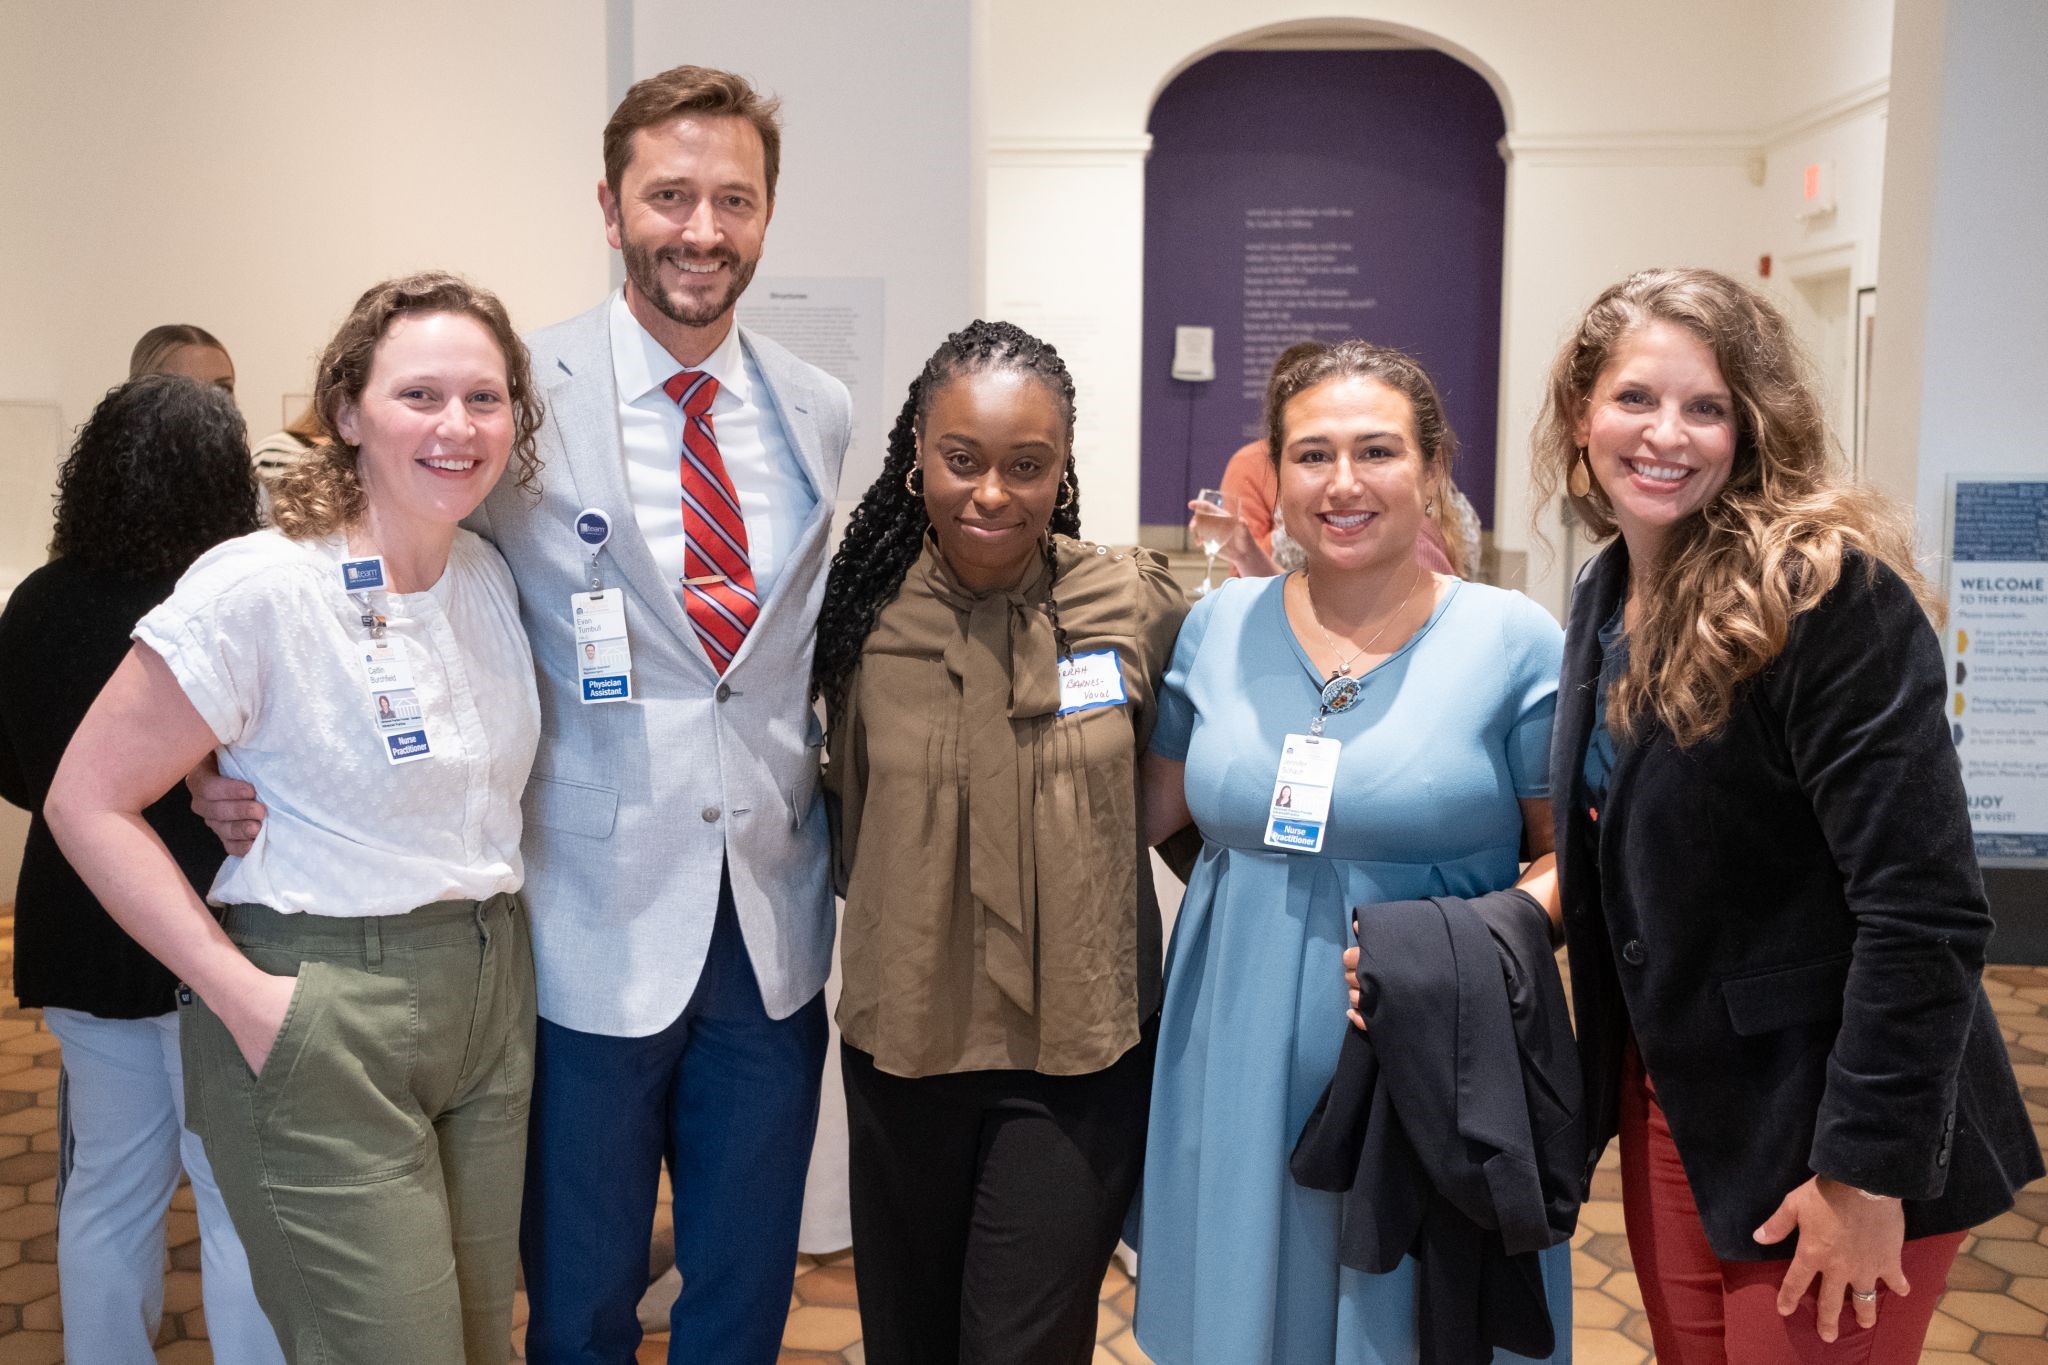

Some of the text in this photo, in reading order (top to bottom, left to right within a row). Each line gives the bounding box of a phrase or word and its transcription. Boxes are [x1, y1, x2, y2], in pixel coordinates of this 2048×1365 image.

[1960, 577, 2044, 591] WELCOME
[1960, 594, 1976, 605] TO
[1978, 594, 1999, 605] THE
[589, 679, 622, 690] Physician
[590, 687, 623, 697] Assistant
[398, 735, 417, 746] Nurse
[392, 743, 427, 757] Practitioner
[1967, 796, 2004, 809] JOY
[1985, 811, 2016, 822] VISIT!
[1284, 825, 1307, 836] Nurse
[1271, 832, 1316, 846] Practitioner
